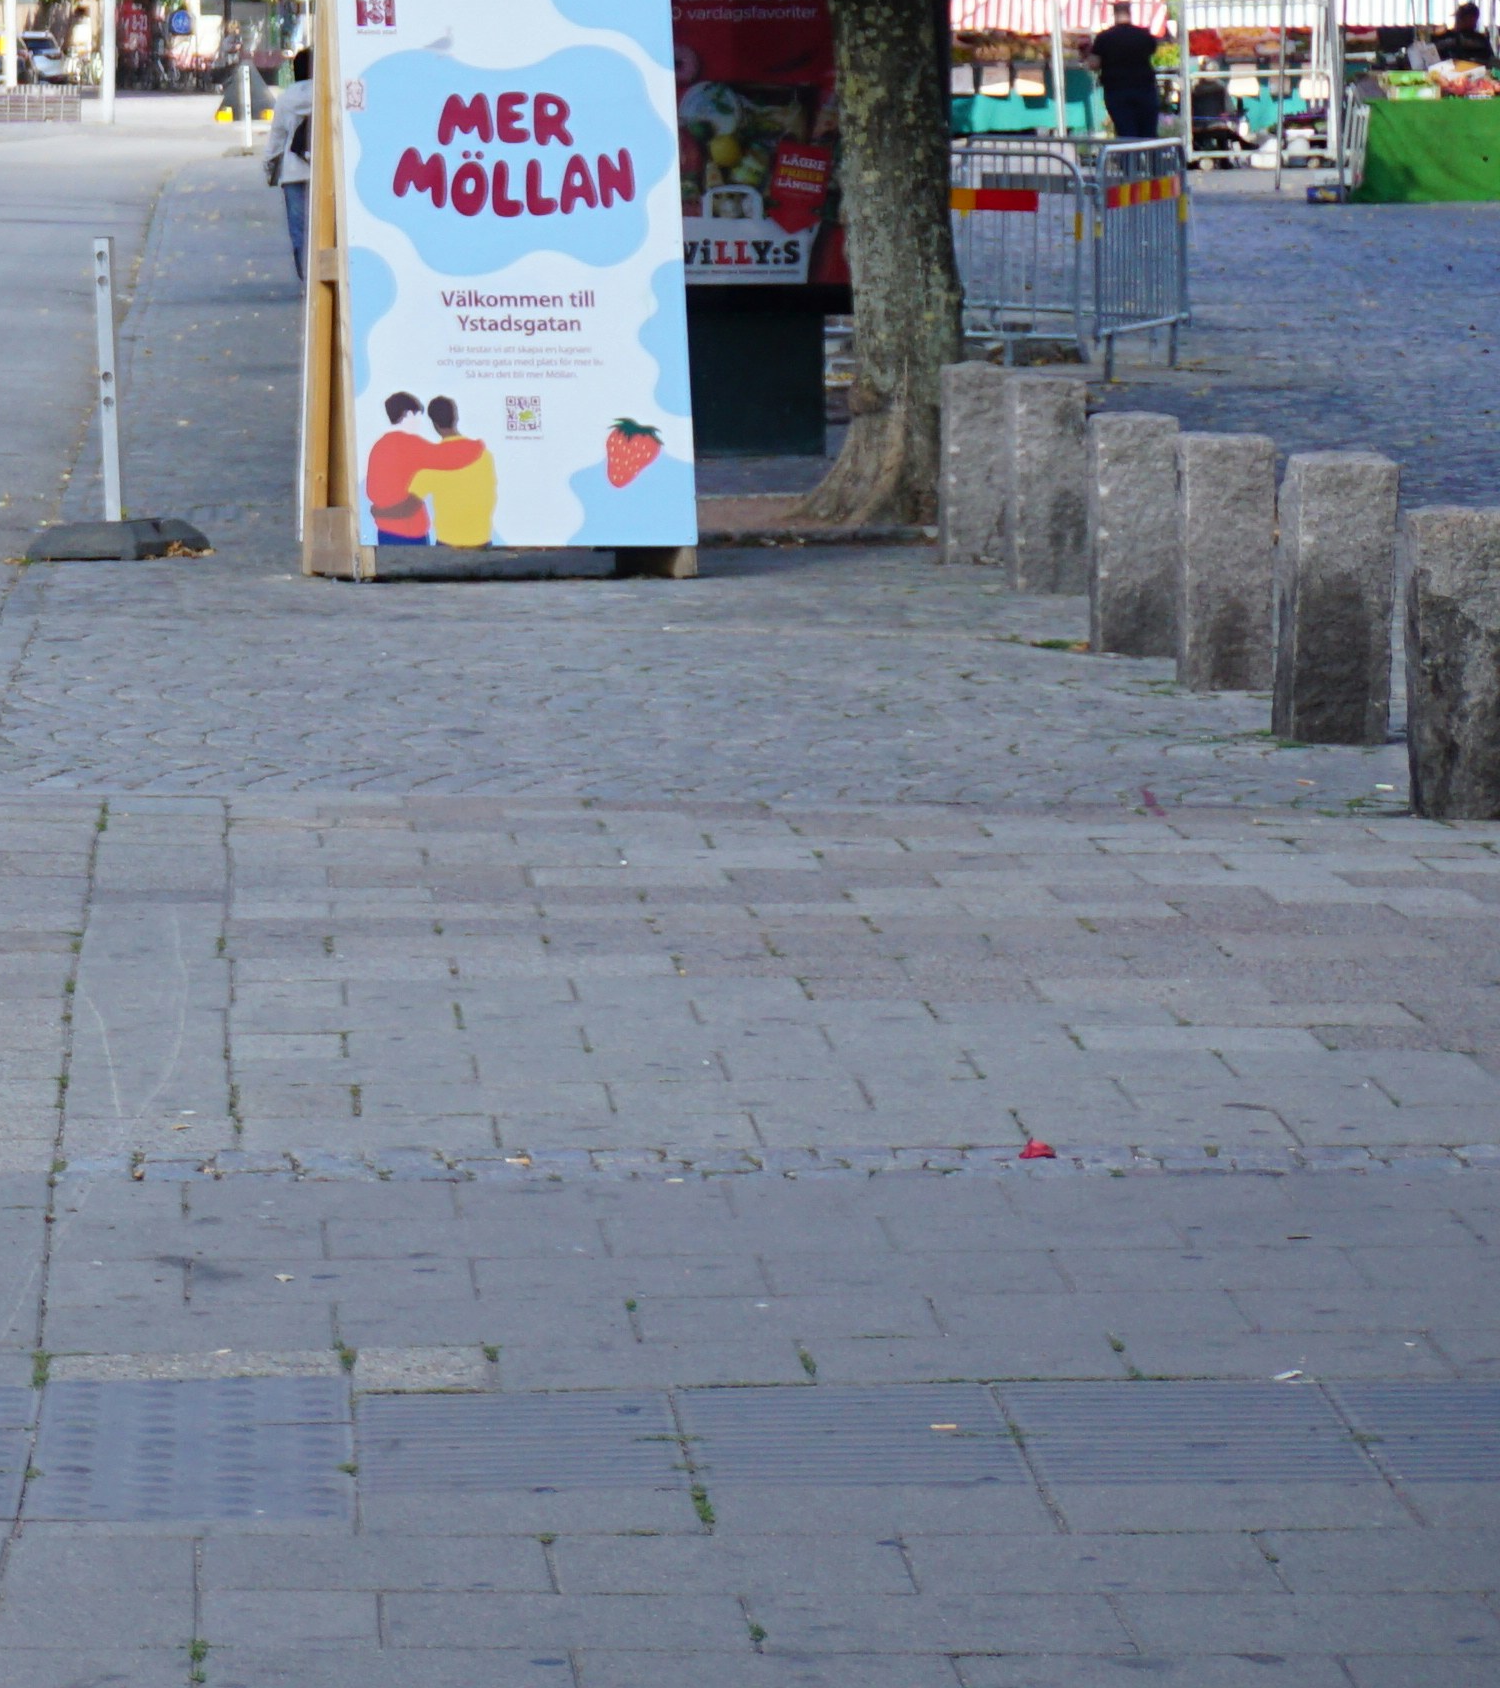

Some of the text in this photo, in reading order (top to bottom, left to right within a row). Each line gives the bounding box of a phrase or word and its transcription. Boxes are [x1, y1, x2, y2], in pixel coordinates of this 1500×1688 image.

[438, 91, 574, 146] MER
[393, 147, 636, 217] MÖLLAN
[441, 290, 595, 308] Välkommen till
[457, 314, 582, 336] Ystadsgatan
